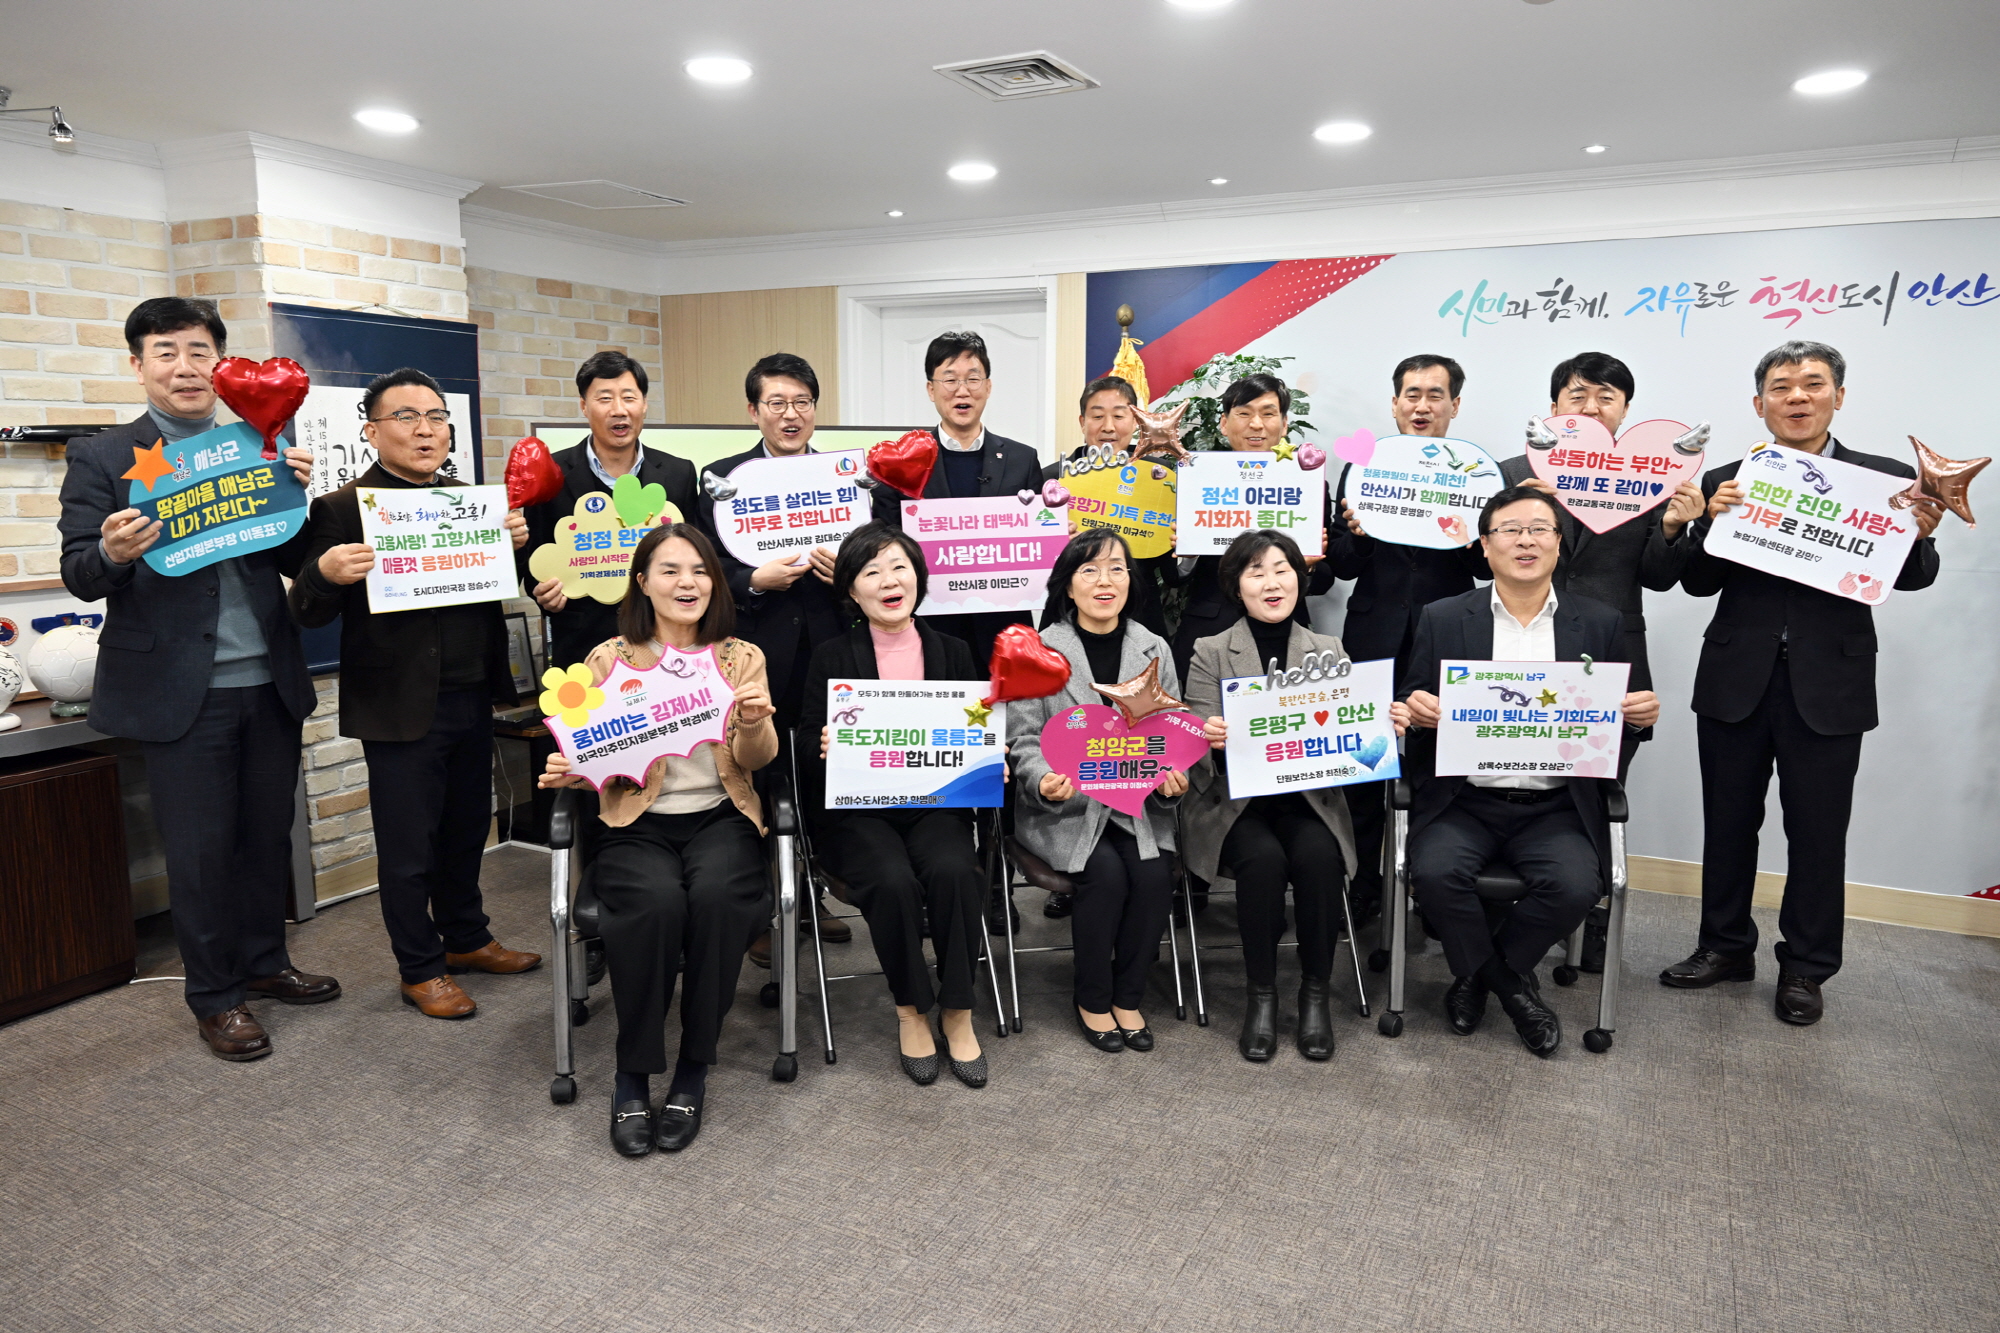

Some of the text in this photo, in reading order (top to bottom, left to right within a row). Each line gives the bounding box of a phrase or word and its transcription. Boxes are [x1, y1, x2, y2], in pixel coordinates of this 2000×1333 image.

[1624, 281, 1740, 338] 자유로운
[1749, 271, 1900, 329] 혁신도시
[1907, 272, 2000, 313] 안산
[194, 441, 241, 472] 해남군
[1059, 442, 1130, 479] hello
[1547, 448, 1684, 476] 생동하는 부안~
[1764, 459, 1787, 472] 진안군
[1239, 471, 1264, 480] 정선군
[1362, 468, 1468, 488] 청풍명월의 도시 제천!
[1556, 474, 1649, 497] 함께 또 같이
[156, 481, 216, 520] 땅끝마을
[218, 468, 275, 498] 해남군
[731, 486, 858, 516] 청도를 살리는 힘!
[1202, 487, 1302, 506] 정선 아리랑
[1360, 482, 1417, 501] 안산시가
[450, 503, 487, 522] 고흥!
[1109, 503, 1140, 522] 가득
[1358, 501, 1399, 515] 상록구청장
[1567, 497, 1615, 510] 환경교통국장
[1749, 479, 1906, 537] 찐한 진안 사랑~
[170, 496, 268, 539] 내가 지킨다~
[734, 506, 852, 534] 기부로 전합니다
[918, 512, 1029, 532] 눈꽃나라 태백시
[1194, 509, 1308, 529] 지화자 좋다~
[374, 528, 501, 552] 고흥사랑! 고향사랑!
[573, 530, 612, 551] 청정
[1738, 503, 1875, 558] 기부로 전합니다
[164, 521, 278, 569] 산업지원본부장 이동표
[757, 535, 813, 551] 안산시부시장
[1733, 530, 1795, 556] 농업기술센터장
[382, 551, 496, 574] 마음껏 응원하자~
[568, 555, 598, 567] 사랑의
[600, 553, 630, 564] 시작은
[935, 541, 1042, 566] 사랑합니다!
[580, 568, 627, 579] 기획경제실장
[413, 583, 466, 597] 도시디자인국장
[949, 577, 1020, 591] 안산시장 이민근
[1265, 650, 1352, 691] hello
[1475, 672, 1546, 681] 광주광역시 남구
[858, 690, 880, 698] 모두가
[881, 690, 896, 698] 함께
[898, 690, 934, 698] 만들어가는
[1331, 687, 1350, 700] 은평
[571, 687, 713, 750] 웅비하는 김제시!
[1164, 714, 1181, 726] 기부
[1249, 702, 1376, 737] 은평구 안산
[1452, 709, 1617, 723] 내일이 빛나는 기회도시
[837, 728, 996, 746] 독도지킴이 울릉군을
[1475, 725, 1588, 739] 광주광역시 남구
[576, 721, 680, 764] 외국인주민지원본부장
[1086, 735, 1167, 758] 청양군을
[1265, 732, 1362, 763] 응원합니다
[869, 750, 963, 768] 응원합니다!
[1477, 761, 1537, 770] 상록수보건소장
[1078, 759, 1173, 781] 응원해유~
[1276, 770, 1324, 784] 단원보건소장
[1080, 782, 1129, 791] 문화체육관광국장
[835, 795, 909, 805] 상하수도사업소장
